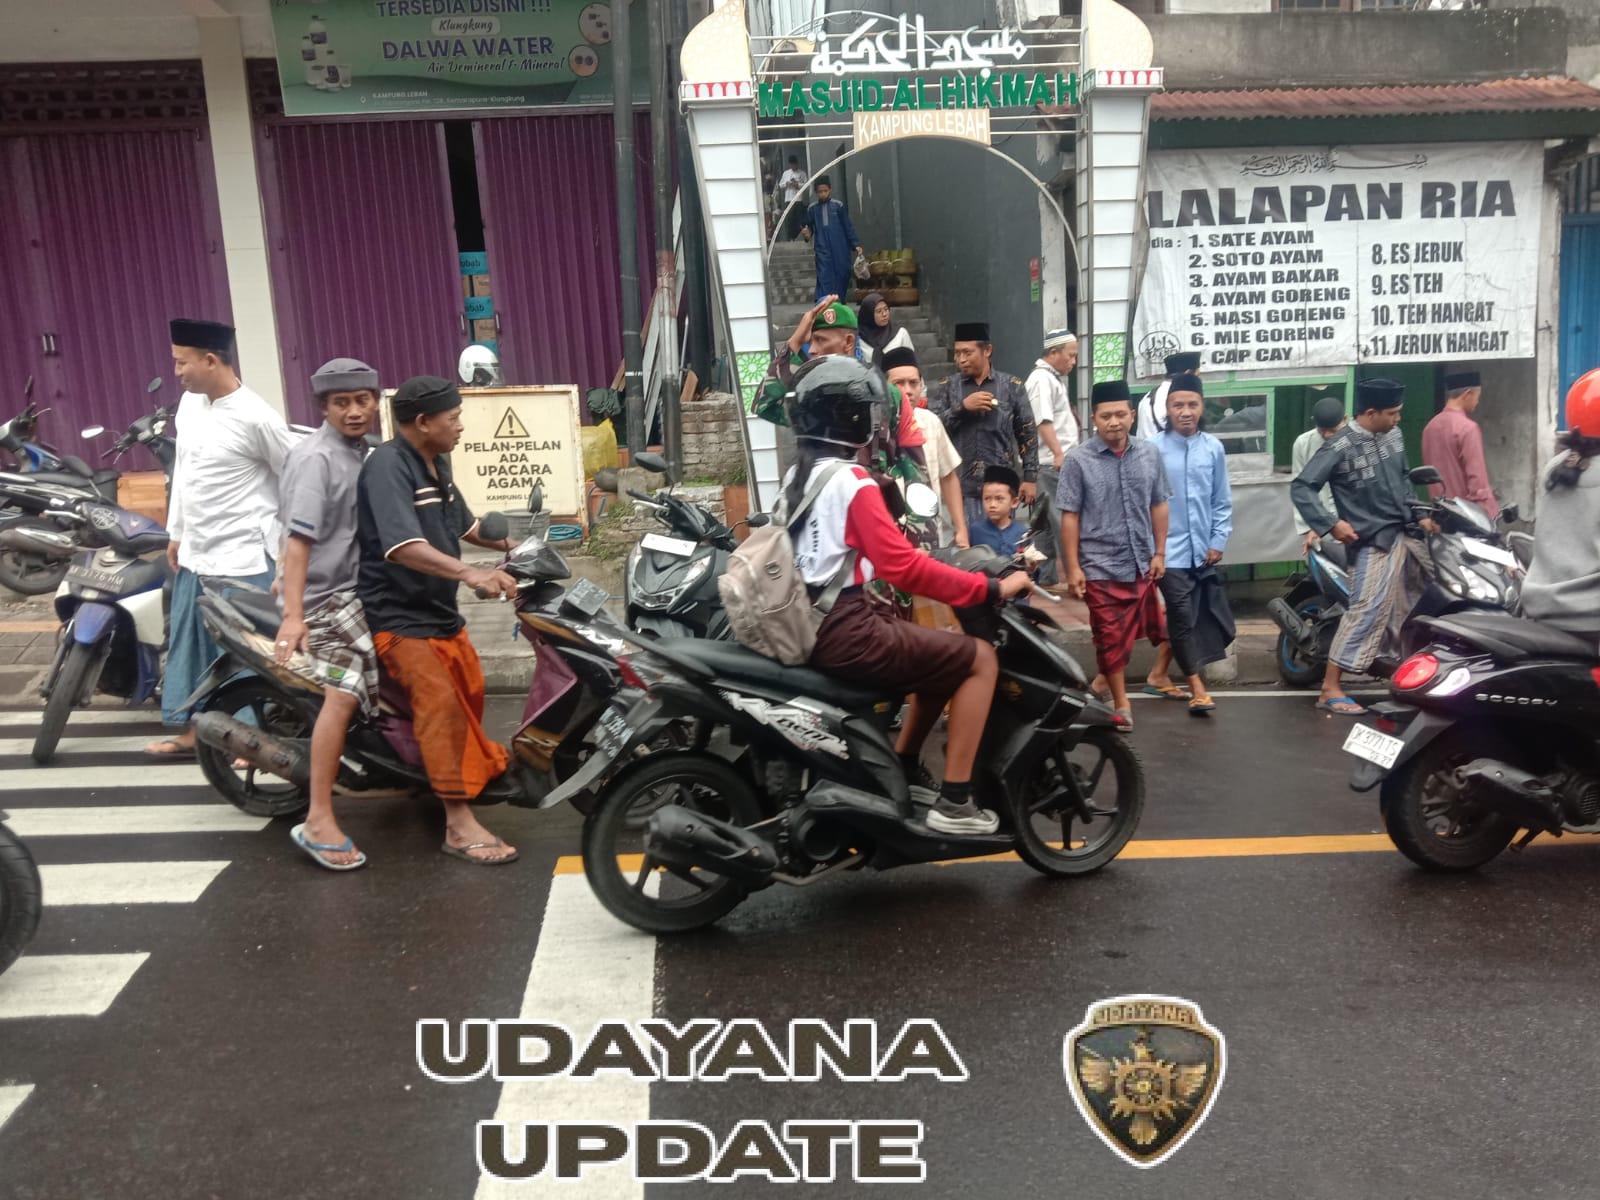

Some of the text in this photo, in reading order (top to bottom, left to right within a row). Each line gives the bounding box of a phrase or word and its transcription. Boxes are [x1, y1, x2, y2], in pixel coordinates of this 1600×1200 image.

[377, 0, 465, 17] TERSEDIA
[470, 0, 525, 14] DISINI
[382, 37, 553, 59] DALWA WATER
[427, 62, 444, 73] Air
[520, 58, 564, 71] Mineral
[758, 71, 1081, 117] MASJID AL HIKMAH
[857, 113, 989, 144] KAMPUNG LEBAH
[1148, 180, 1516, 228] LALAPAN RIA
[1188, 230, 1314, 248] 1. SATE AYAM
[1188, 249, 1323, 268] 2. SOTO AYAM
[1371, 241, 1463, 265] 8. ES JERUK
[1188, 268, 1340, 287] 3. AYAM BAKAR
[1371, 272, 1443, 295] 9. ES TEH
[1188, 287, 1350, 307] 4. AYAM GORENG
[1190, 306, 1345, 327] 5. NASI GORENG
[1371, 301, 1494, 326] 10. TEH HANGAT
[1191, 326, 1335, 346] 6. MIE GORENG
[1370, 331, 1509, 356] 11. JERUK HANGAT
[1211, 347, 1293, 364] CAP CAY
[464, 440, 561, 453] PELAN-PELAN
[499, 453, 529, 463] ADA
[476, 464, 553, 477] UPACARA
[487, 477, 545, 489] AGAMA
